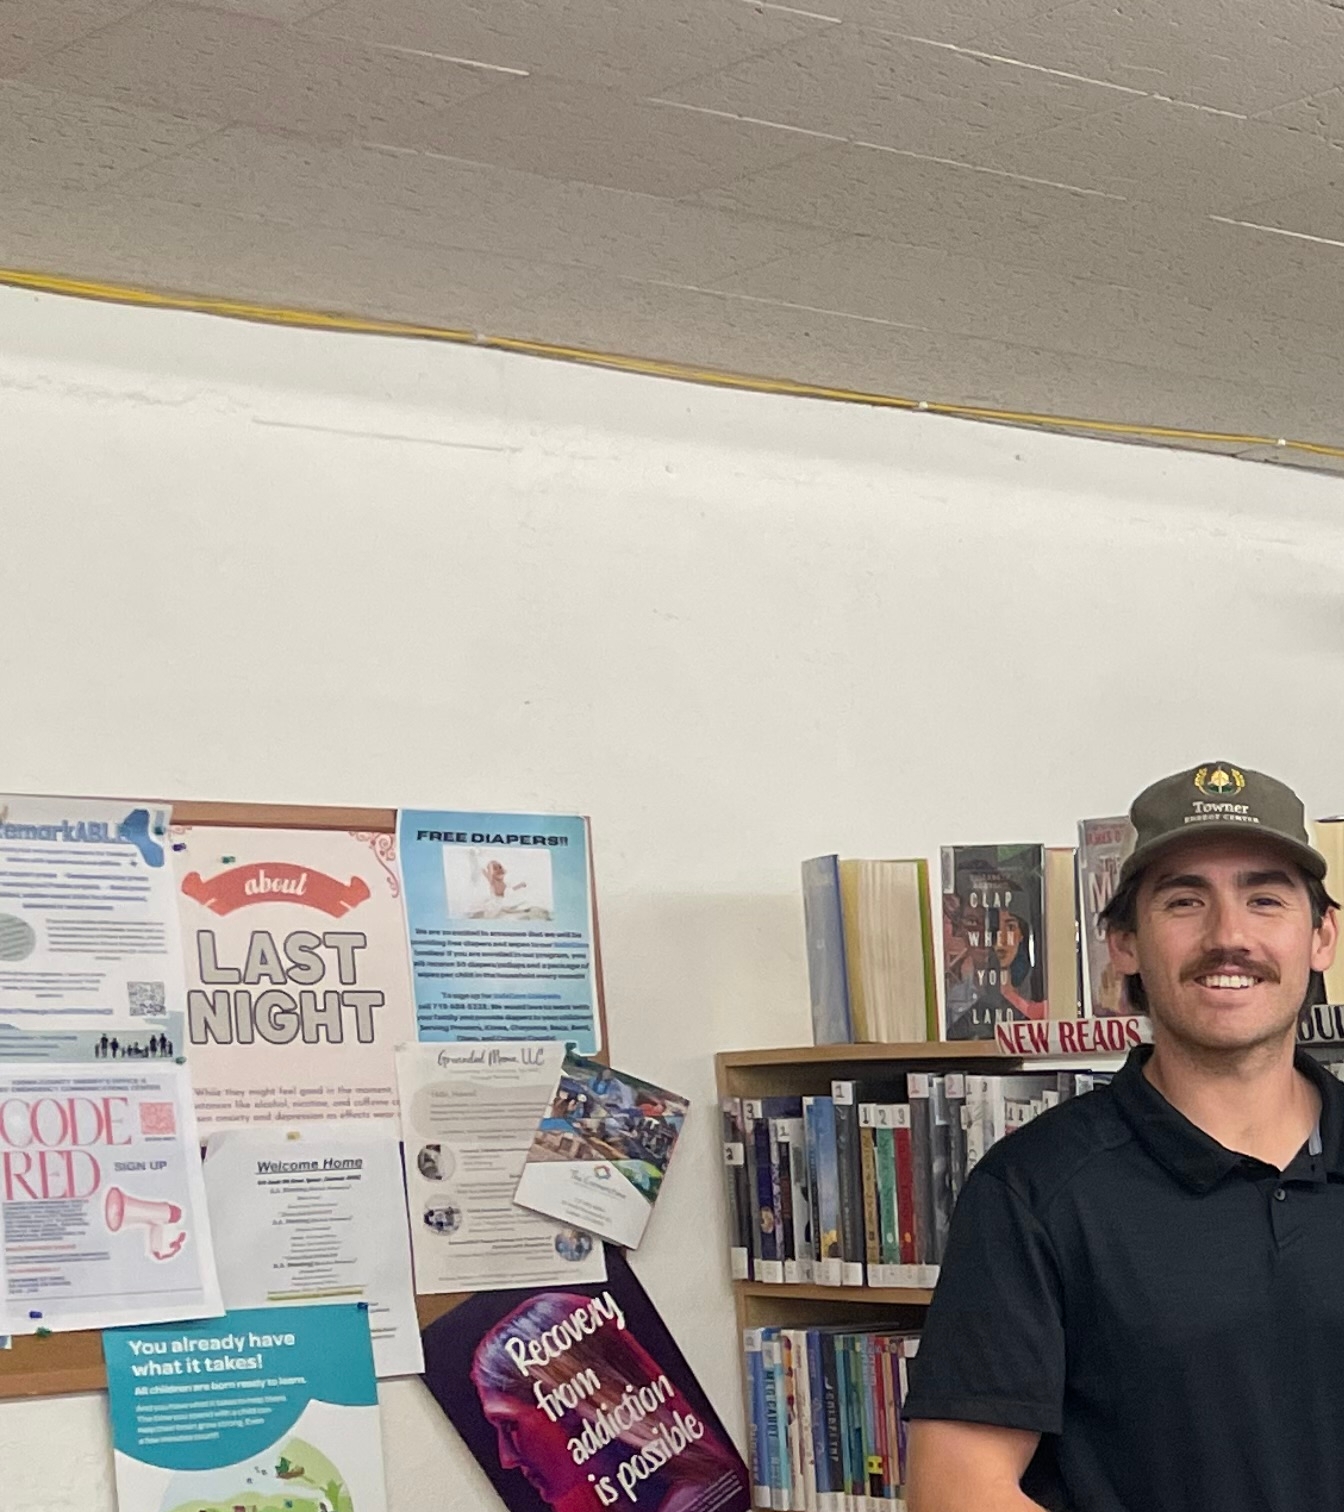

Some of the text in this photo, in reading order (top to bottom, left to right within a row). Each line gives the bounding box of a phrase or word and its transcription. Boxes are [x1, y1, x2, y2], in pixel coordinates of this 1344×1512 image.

[1192, 801, 1249, 814] Towner
[416, 830, 470, 844] FREE
[245, 870, 308, 896] about
[969, 891, 1013, 909] CLAP
[968, 931, 1015, 947] WHEN
[197, 930, 367, 985] LAST
[977, 969, 1008, 986] YOU
[187, 990, 386, 1044] NIGHT
[997, 1018, 1141, 1055] NEW READS
[0, 1096, 132, 1148] CODE
[3, 1150, 102, 1201] RED
[114, 1161, 168, 1172] SIGN UP
[256, 1157, 363, 1174] Welcome Home
[128, 1332, 296, 1356] You already have
[504, 1291, 627, 1378] Recovery
[131, 1354, 263, 1377] what it takes!
[211, 1381, 236, 1390] born
[533, 1367, 602, 1422] from
[766, 1370, 778, 1438] MEG CABOT
[566, 1374, 675, 1466] addiction
[587, 1473, 619, 1506] is
[617, 1410, 705, 1503] possible
